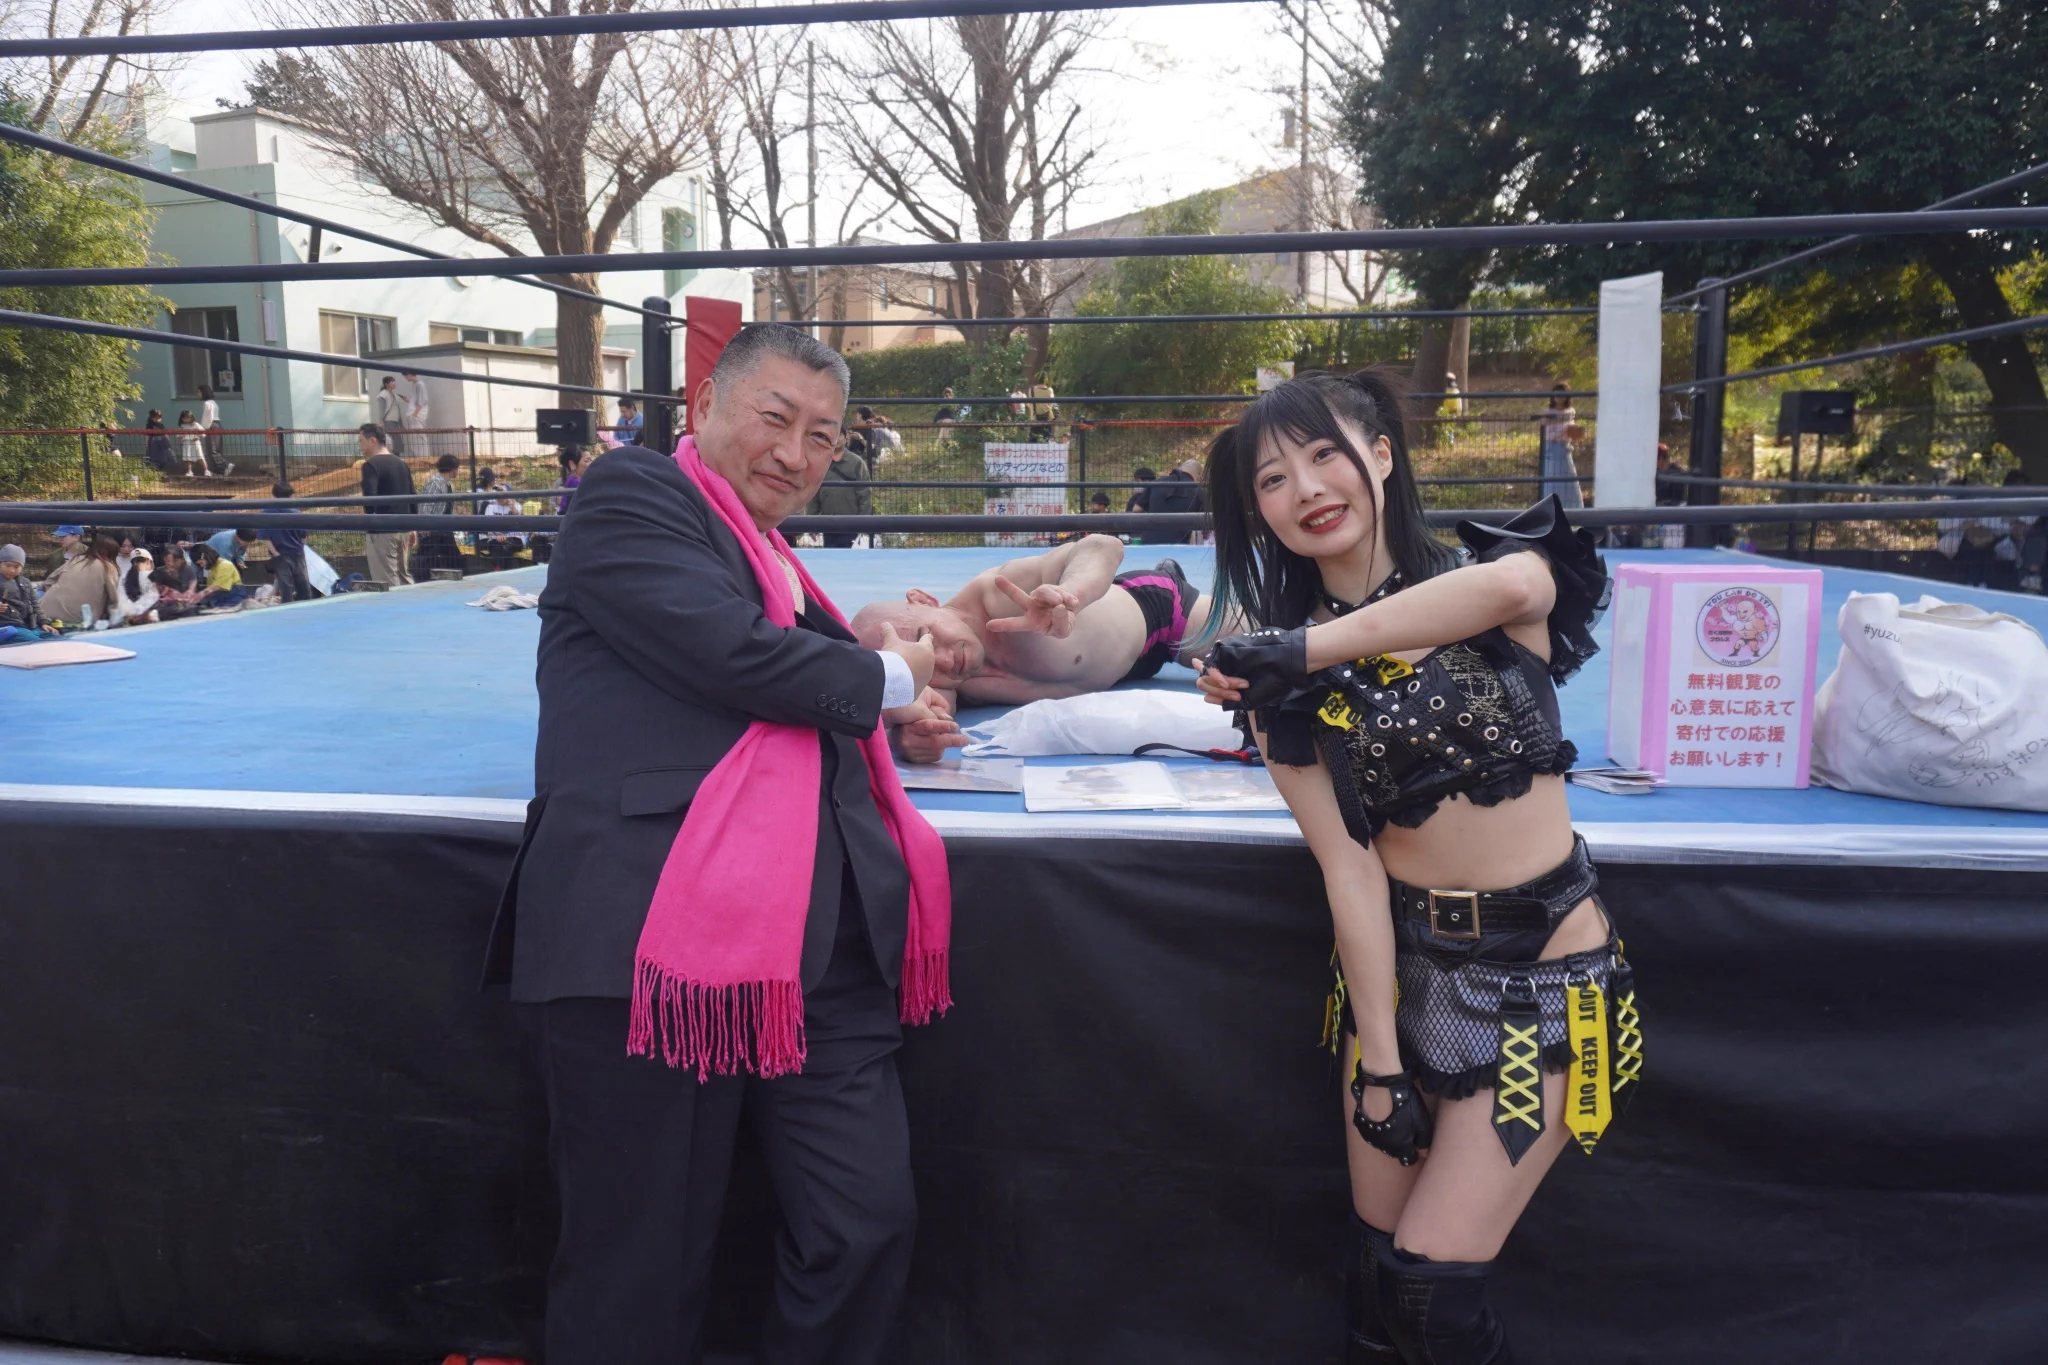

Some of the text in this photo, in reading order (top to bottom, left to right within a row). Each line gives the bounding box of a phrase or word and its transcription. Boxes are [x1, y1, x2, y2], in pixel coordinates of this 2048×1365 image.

[1707, 595, 1722, 608] YOU
[1745, 590, 1757, 598] DO
[1864, 623, 1903, 645] #yuzu
[1688, 673, 1781, 690] 無料観覧の
[1670, 699, 1796, 716] 心意気に応えて
[1676, 725, 1786, 743] 寄付での応援
[1669, 751, 1783, 768] お願いします！
[1579, 989, 1597, 1023] OUT
[1581, 1037, 1599, 1079] KEEP
[1579, 1083, 1597, 1117] OUT
